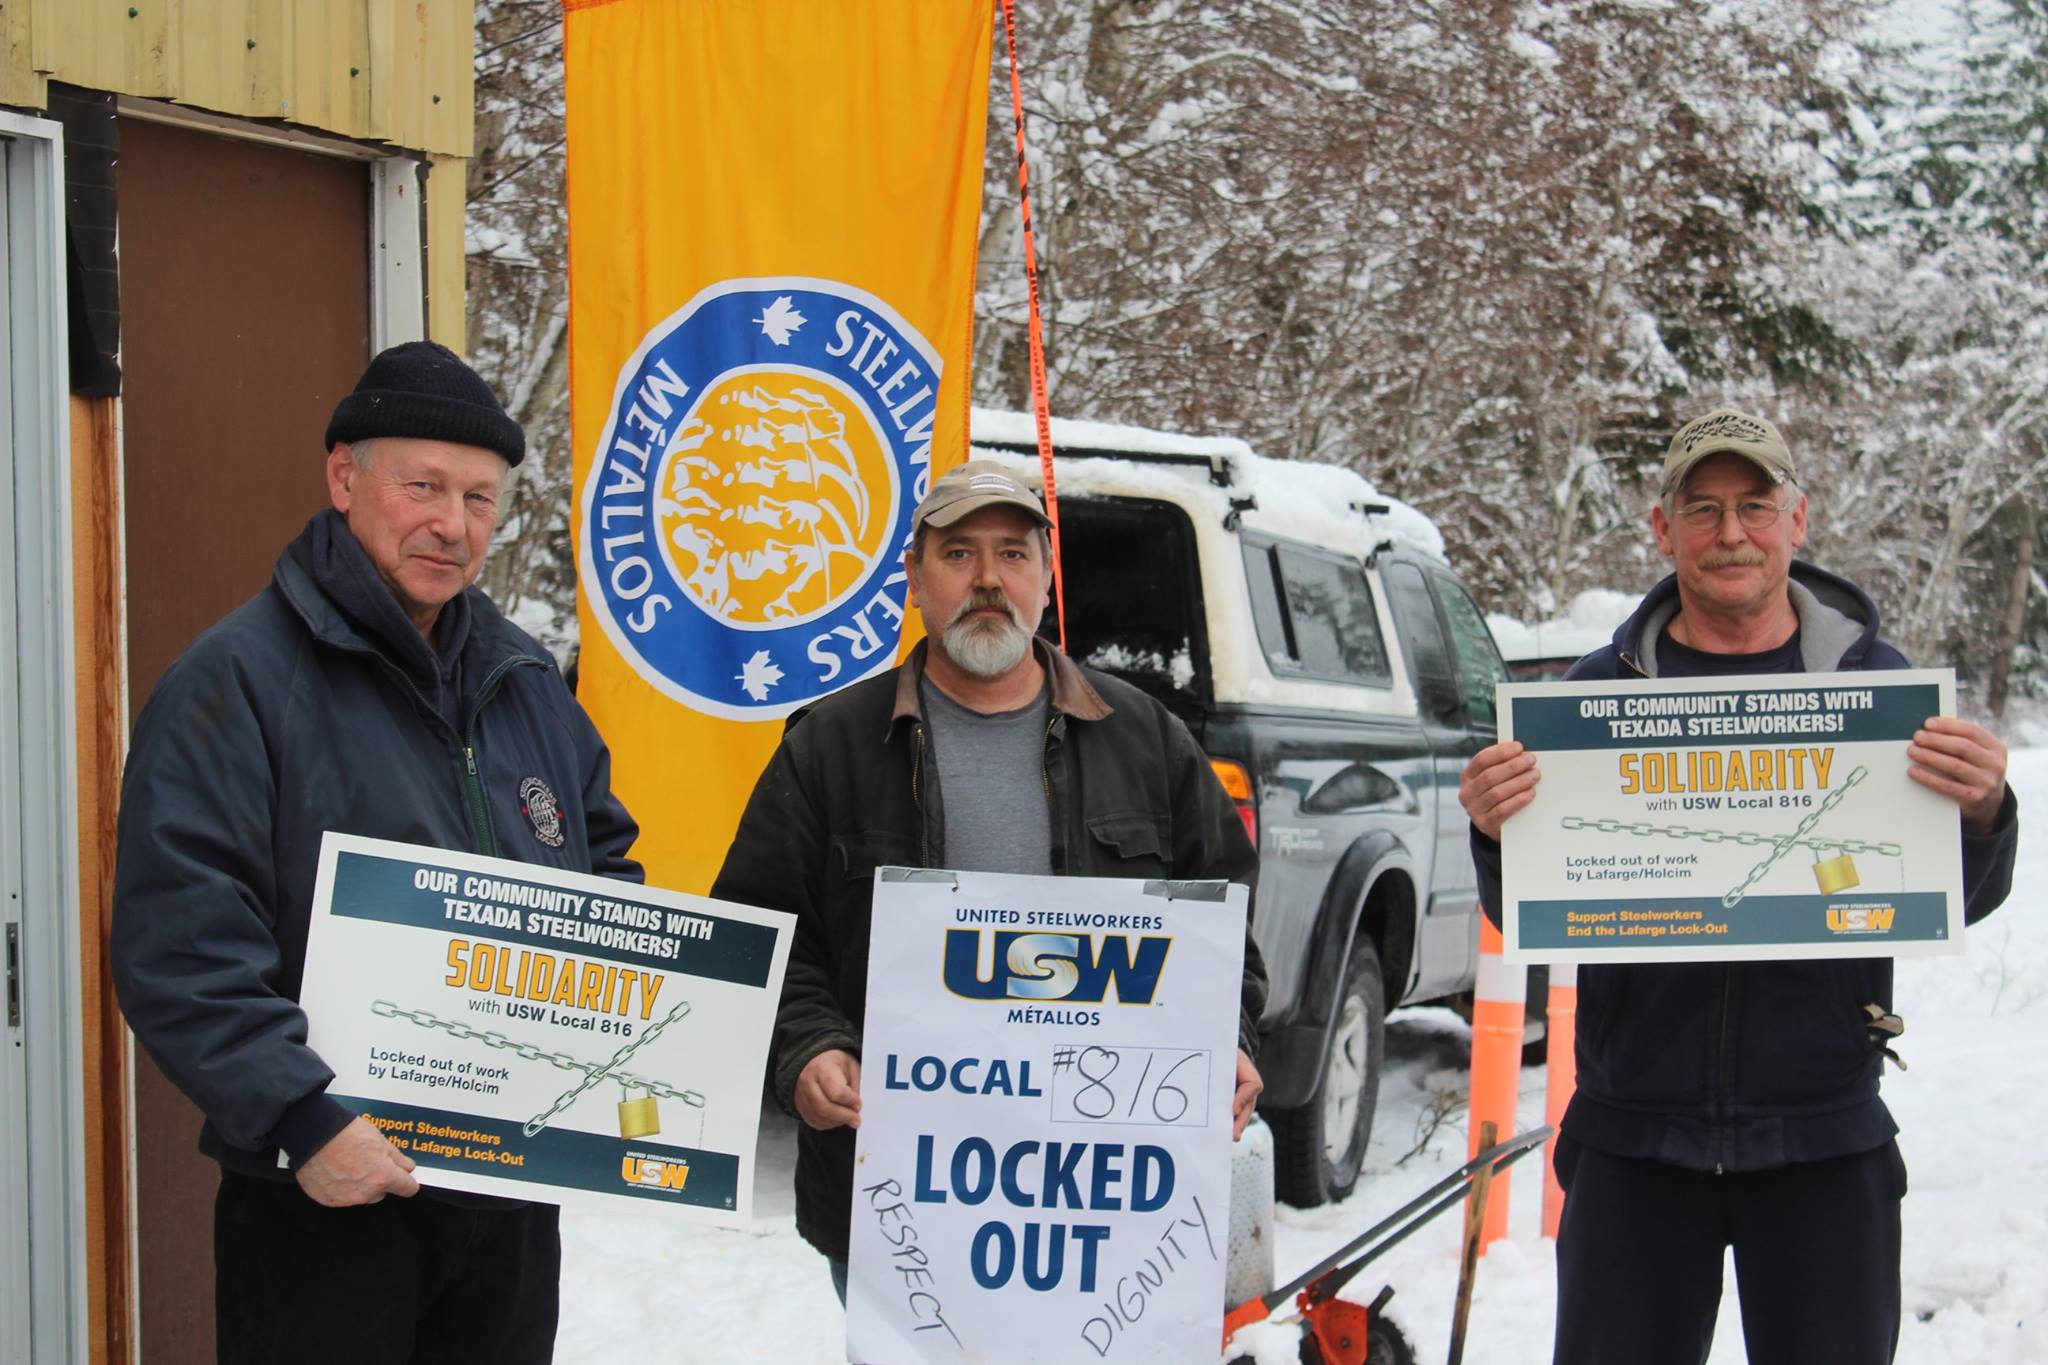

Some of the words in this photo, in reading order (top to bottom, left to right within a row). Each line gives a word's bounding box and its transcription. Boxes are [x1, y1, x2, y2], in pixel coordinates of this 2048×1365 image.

[602, 358, 691, 633] MÉTALLOS
[1580, 699, 1618, 717] OUR
[1624, 694, 1739, 716] COMMUNITY
[1745, 692, 1819, 712] STANDS
[1823, 690, 1872, 709] WITH
[1608, 718, 1682, 738] TEXADA
[1687, 713, 1843, 735] STEELWORKERS!
[1620, 748, 1832, 793] SOLIDARITY
[1644, 797, 1678, 811] with
[1681, 795, 1722, 811] USW
[1726, 794, 1773, 809] Local
[1778, 793, 1812, 808] 816
[1565, 854, 1616, 867] Locked
[1619, 854, 1642, 866] out
[1645, 853, 1661, 865] of
[1663, 852, 1698, 865] work
[1565, 868, 1583, 883] by
[1585, 866, 1692, 882] Lafarge/Holcim
[414, 868, 457, 894] OUR
[463, 876, 585, 915] COMMUNITY
[588, 898, 661, 930] STANDS
[666, 913, 713, 940] WITH
[956, 907, 1020, 925] UNITED
[1027, 910, 1163, 930] STEELWORKERS
[1566, 910, 1617, 923] Support
[1617, 910, 1704, 921] Steelworkers
[1826, 908, 1896, 930] USW
[443, 897, 521, 930] TEXADA
[526, 912, 680, 959] STEELWORKERS!
[1566, 924, 1593, 937] End
[1594, 925, 1617, 936] the
[1616, 924, 1667, 938] Lafarge
[1668, 921, 1729, 935] Lock-Out
[445, 939, 664, 1020] SOLIDARITY
[942, 928, 1174, 1006] USW
[467, 997, 501, 1015] with
[505, 1001, 546, 1022] USW
[549, 1008, 596, 1031] Local
[599, 1018, 632, 1037] 816
[1007, 1006, 1101, 1027] MÉTALLOS
[367, 1061, 387, 1080] by
[390, 1065, 500, 1095] Lafarge/Holcim
[369, 1046, 426, 1067] Locked
[428, 1058, 454, 1072] out
[456, 1061, 471, 1074] of
[474, 1065, 510, 1081] work
[885, 1054, 1042, 1097] LOCAL
[415, 1120, 501, 1145] Steelworkers
[410, 1138, 462, 1158] Lafarge
[462, 1146, 525, 1166] Lock-Out
[622, 1156, 690, 1190] USW
[914, 1135, 1175, 1212] LOCKED
[862, 1178, 964, 1352] RESPECT
[970, 1221, 1111, 1293] OUT
[1080, 1195, 1219, 1357] DIGNITY
